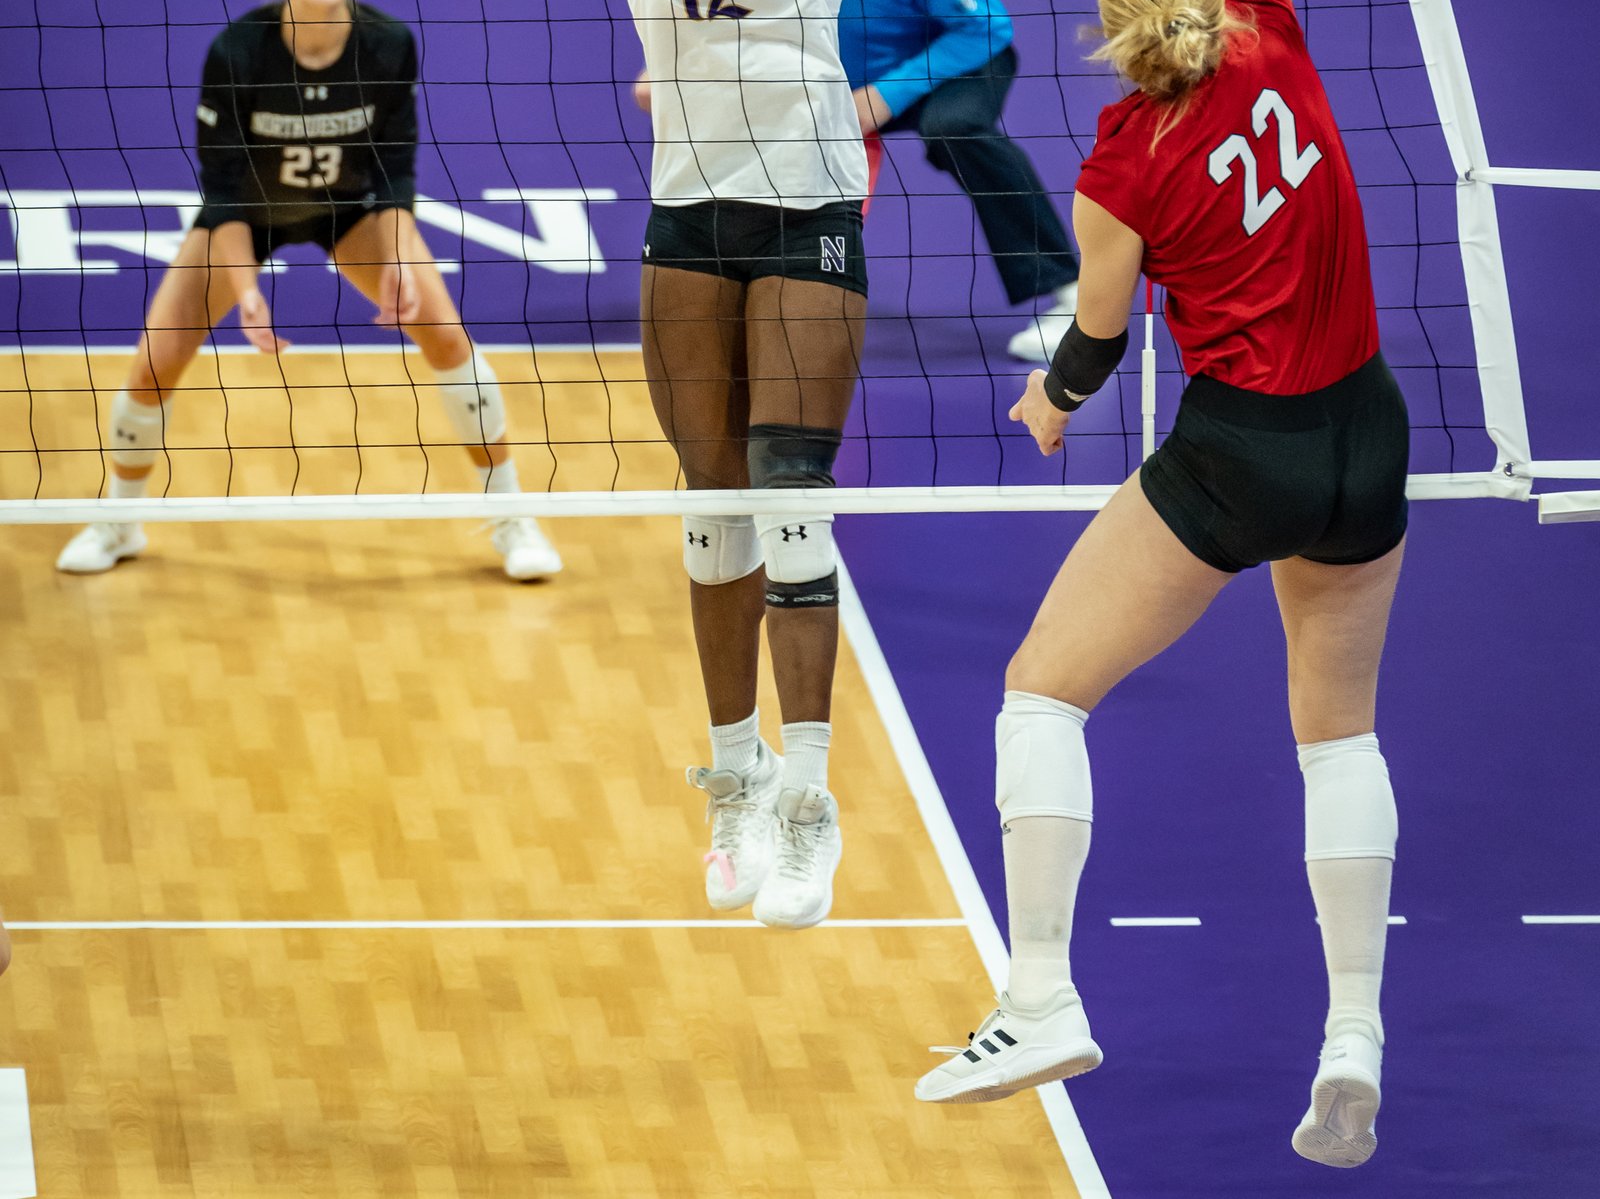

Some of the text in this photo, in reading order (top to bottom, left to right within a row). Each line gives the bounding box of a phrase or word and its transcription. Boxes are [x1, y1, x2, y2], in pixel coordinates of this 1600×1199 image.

[279, 144, 343, 188] 23
[1208, 87, 1323, 237] 22
[820, 235, 845, 273] N
